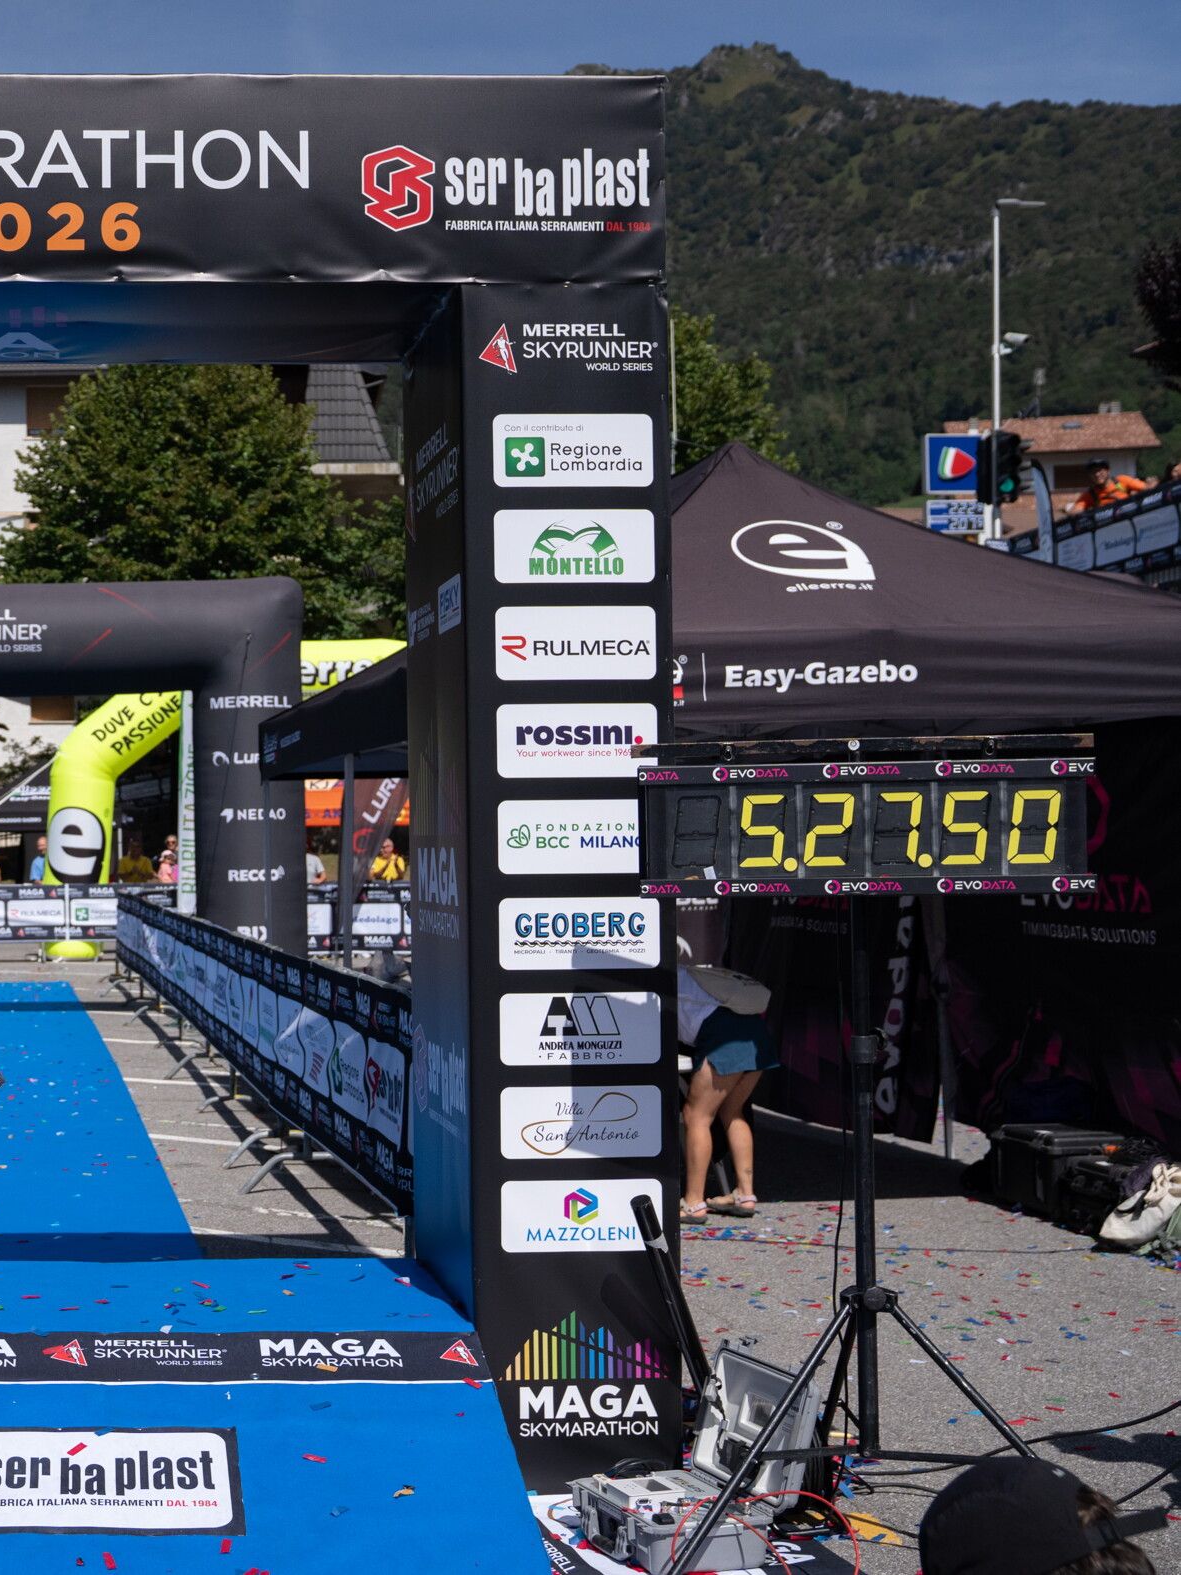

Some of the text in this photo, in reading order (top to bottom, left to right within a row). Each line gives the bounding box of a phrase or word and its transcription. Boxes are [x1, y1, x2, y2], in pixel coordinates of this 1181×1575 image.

[445, 220, 651, 232] FABBRICA ITALIANA SERRAMENTI DAL 1984
[523, 324, 625, 337] MERRELL
[586, 363, 653, 371] WORLD SERIES
[531, 424, 573, 432] contributo
[551, 443, 622, 458] Regione
[551, 458, 642, 471] Lombardia
[529, 557, 624, 575] MONTELLO
[13, 644, 42, 652] SERIES
[725, 660, 918, 694] Easy-Gazebo
[210, 695, 292, 710] MERRELL
[91, 706, 135, 742] DOVE
[111, 695, 182, 756] PASSIONE
[517, 748, 631, 757] Your workwear since 196
[730, 769, 788, 779] EVODATA
[840, 764, 900, 776] EVODATA
[953, 764, 1015, 773] EVODATA
[536, 823, 635, 831] FONDAZION
[536, 836, 569, 848] BCC
[732, 883, 791, 892] EVODATA
[842, 881, 902, 893] EVODATA
[955, 881, 1016, 890] EVODATA
[515, 912, 646, 938] GEOBERG
[1022, 921, 1157, 945] TIMING&DATA SOLUTIONS
[539, 1041, 622, 1050] ANDREA MONGUZZI
[547, 1052, 615, 1060] FABBRO
[555, 1102, 584, 1116] Villa
[526, 1227, 636, 1242] MAZZOLENI
[259, 1338, 402, 1357] MAGA
[260, 1356, 404, 1368] SKYMARATHON
[519, 1384, 658, 1419] MAGA
[519, 1421, 659, 1437] SKYMARATHON
[37, 1498, 88, 1506] ITALIANA
[90, 1498, 163, 1507] SERRAMENTI
